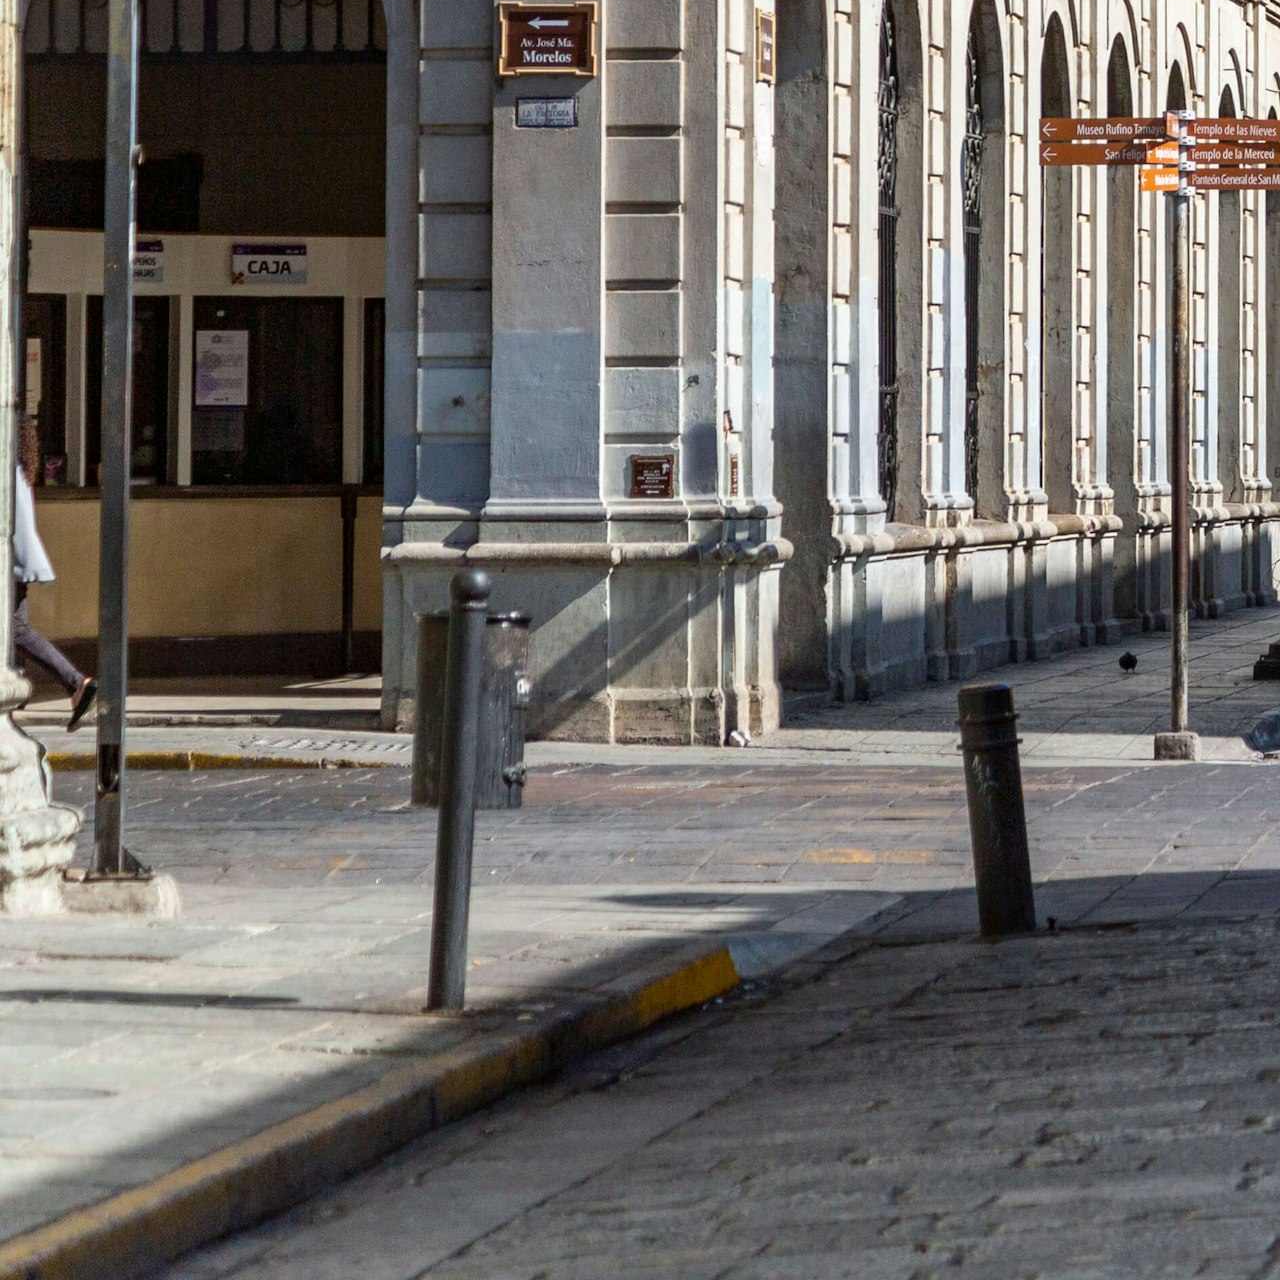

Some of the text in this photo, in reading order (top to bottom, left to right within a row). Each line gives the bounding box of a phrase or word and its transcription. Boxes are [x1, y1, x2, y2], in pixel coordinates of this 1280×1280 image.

[520, 38, 574, 48] Av. José Ma.
[523, 50, 572, 63] Morelos
[1076, 123, 1104, 135] Museo
[1105, 123, 1133, 135] Rufino
[1134, 123, 1165, 137] Tamayo
[1193, 123, 1223, 137] Templo
[1224, 124, 1235, 134] de
[1236, 124, 1248, 135] las
[1249, 124, 1277, 137] Nieves
[1104, 148, 1121, 160] San
[1191, 148, 1221, 162] Templo
[1222, 149, 1234, 159] de
[1235, 149, 1243, 159] la
[1244, 148, 1275, 159] Merced
[1192, 174, 1221, 185] Panteón
[1221, 174, 1248, 185] General
[1248, 175, 1258, 185] de
[1258, 175, 1272, 185] San
[247, 260, 292, 275] CAJA
